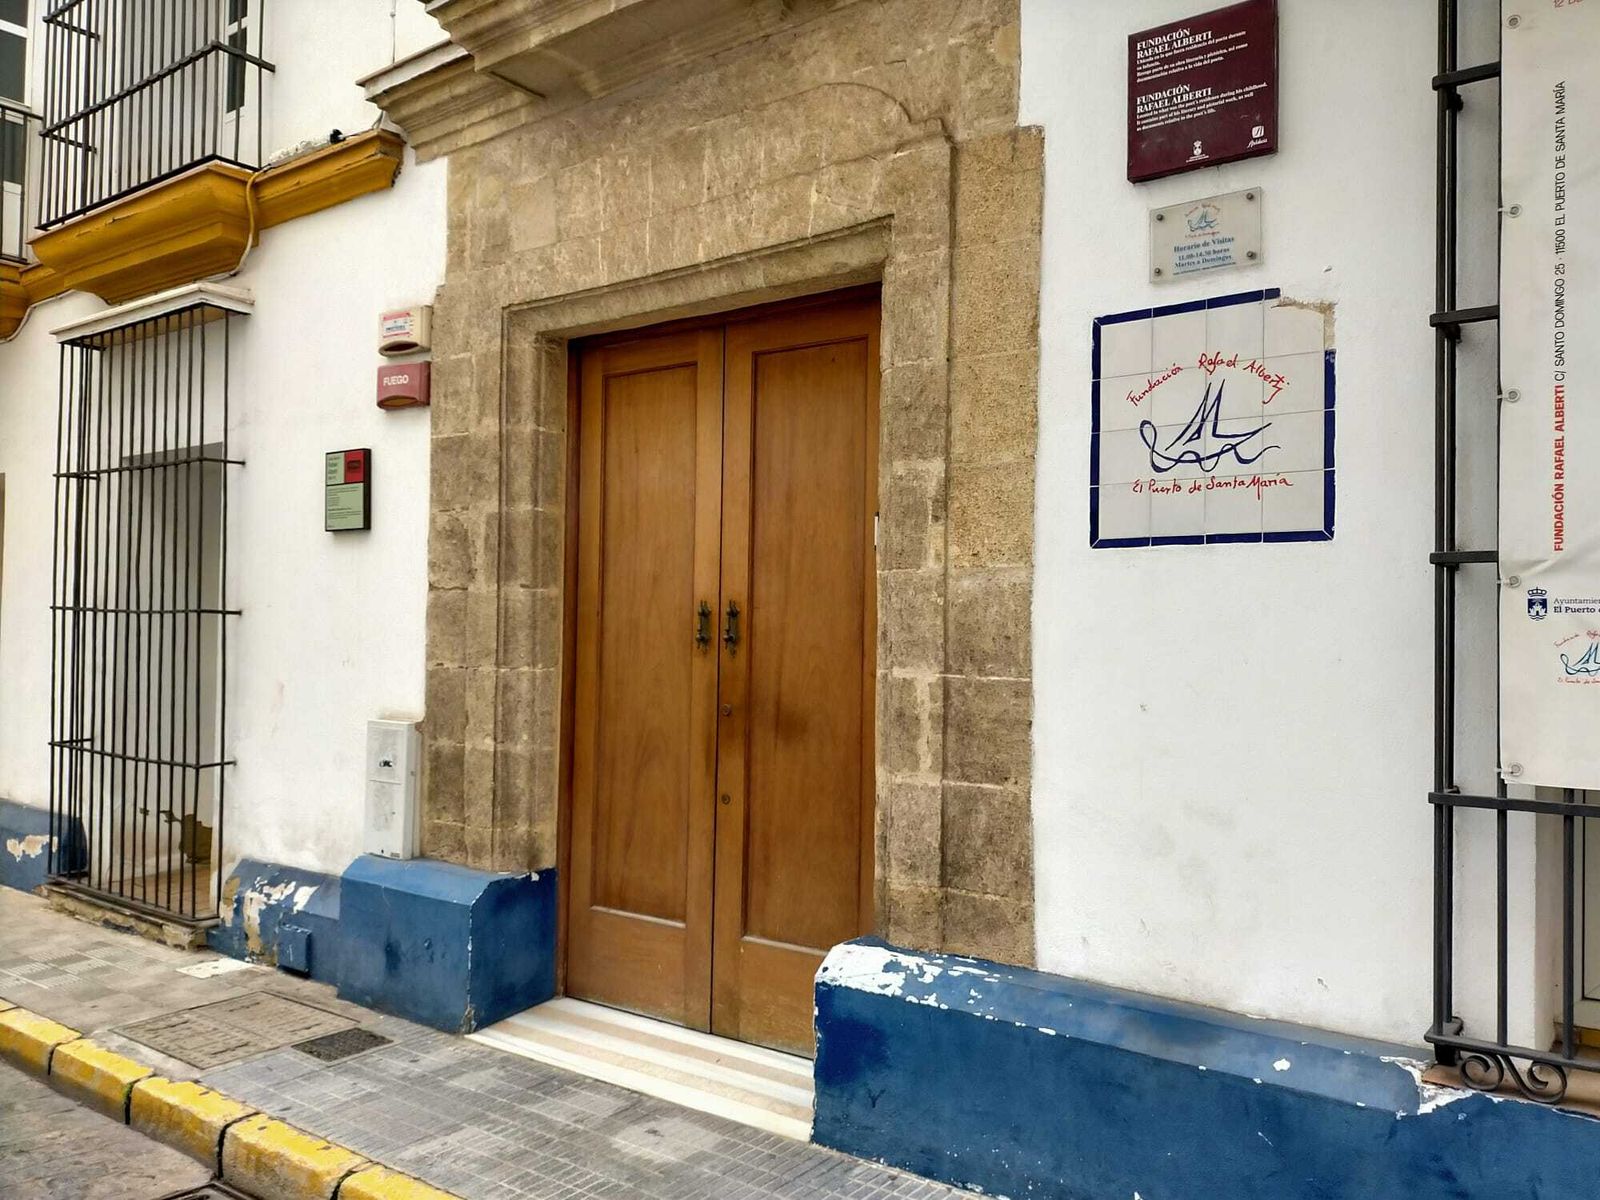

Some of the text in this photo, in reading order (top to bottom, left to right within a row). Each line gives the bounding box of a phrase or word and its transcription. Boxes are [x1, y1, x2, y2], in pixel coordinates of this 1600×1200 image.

[1137, 28, 1190, 50] FUNDACIÓN
[1137, 30, 1212, 59] RAFAEL ALBERTI
[1137, 84, 1190, 105] FUNDACIÓN
[1137, 87, 1212, 114] RAFAEL ALBERTI
[1211, 236, 1234, 245] Visitas
[1552, 80, 1566, 552] FUNDACIÓN RAFAEL ALBERTI C/ SANTO DOMINGO 25 11500 EL PUERTO DE SANTA MARÍA
[383, 374, 409, 386] FUEGO
[1126, 363, 1183, 406] Fundación
[1198, 352, 1238, 376] Rafael
[1132, 472, 1294, 500] El Puerto de Santa María
